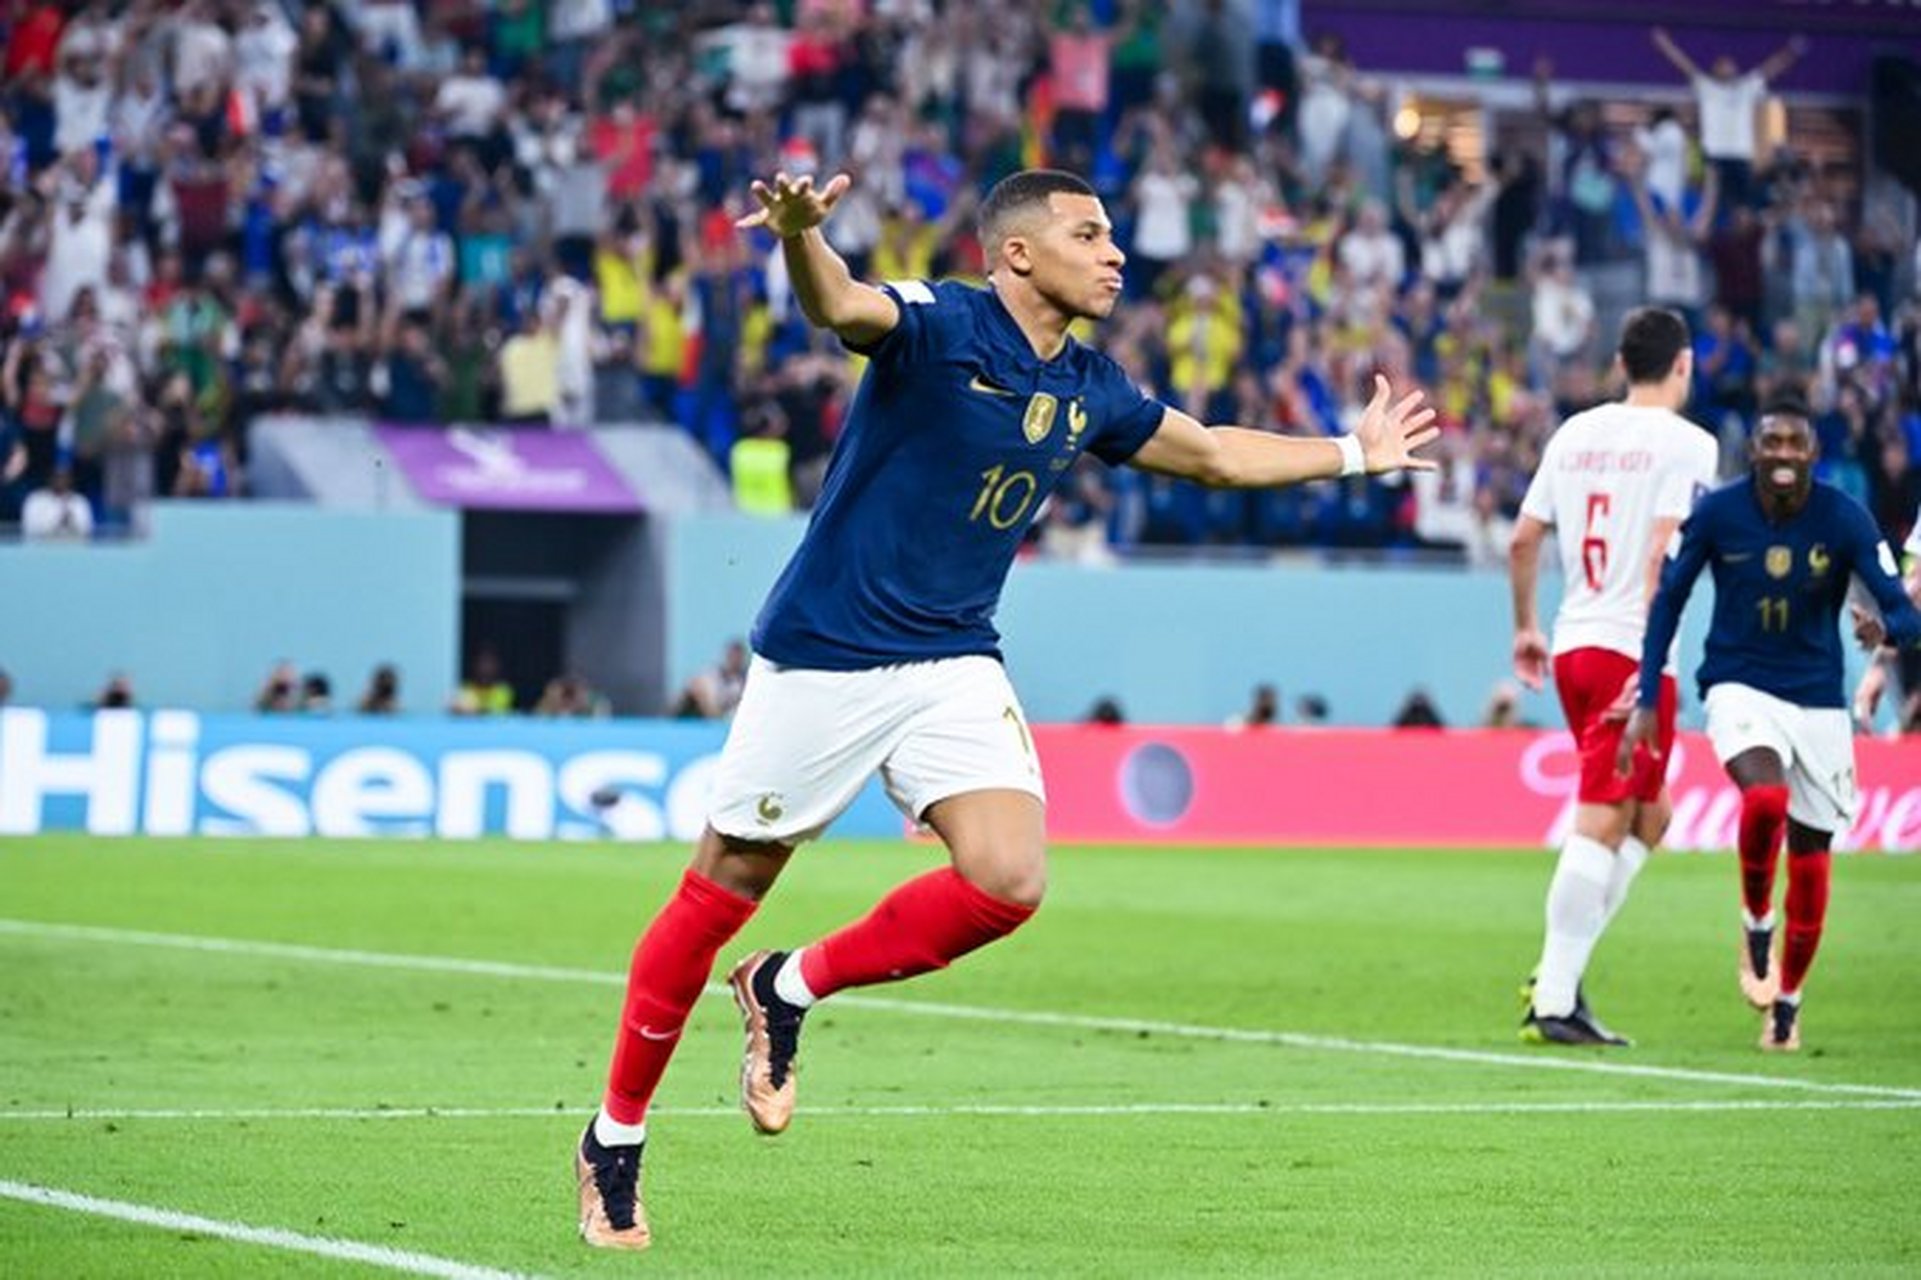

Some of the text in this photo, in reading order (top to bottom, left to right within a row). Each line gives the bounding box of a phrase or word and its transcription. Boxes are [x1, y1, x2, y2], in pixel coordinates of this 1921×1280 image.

[969, 465, 1036, 530] 10
[1581, 493, 1609, 593] 6
[1757, 597, 1790, 632] 11
